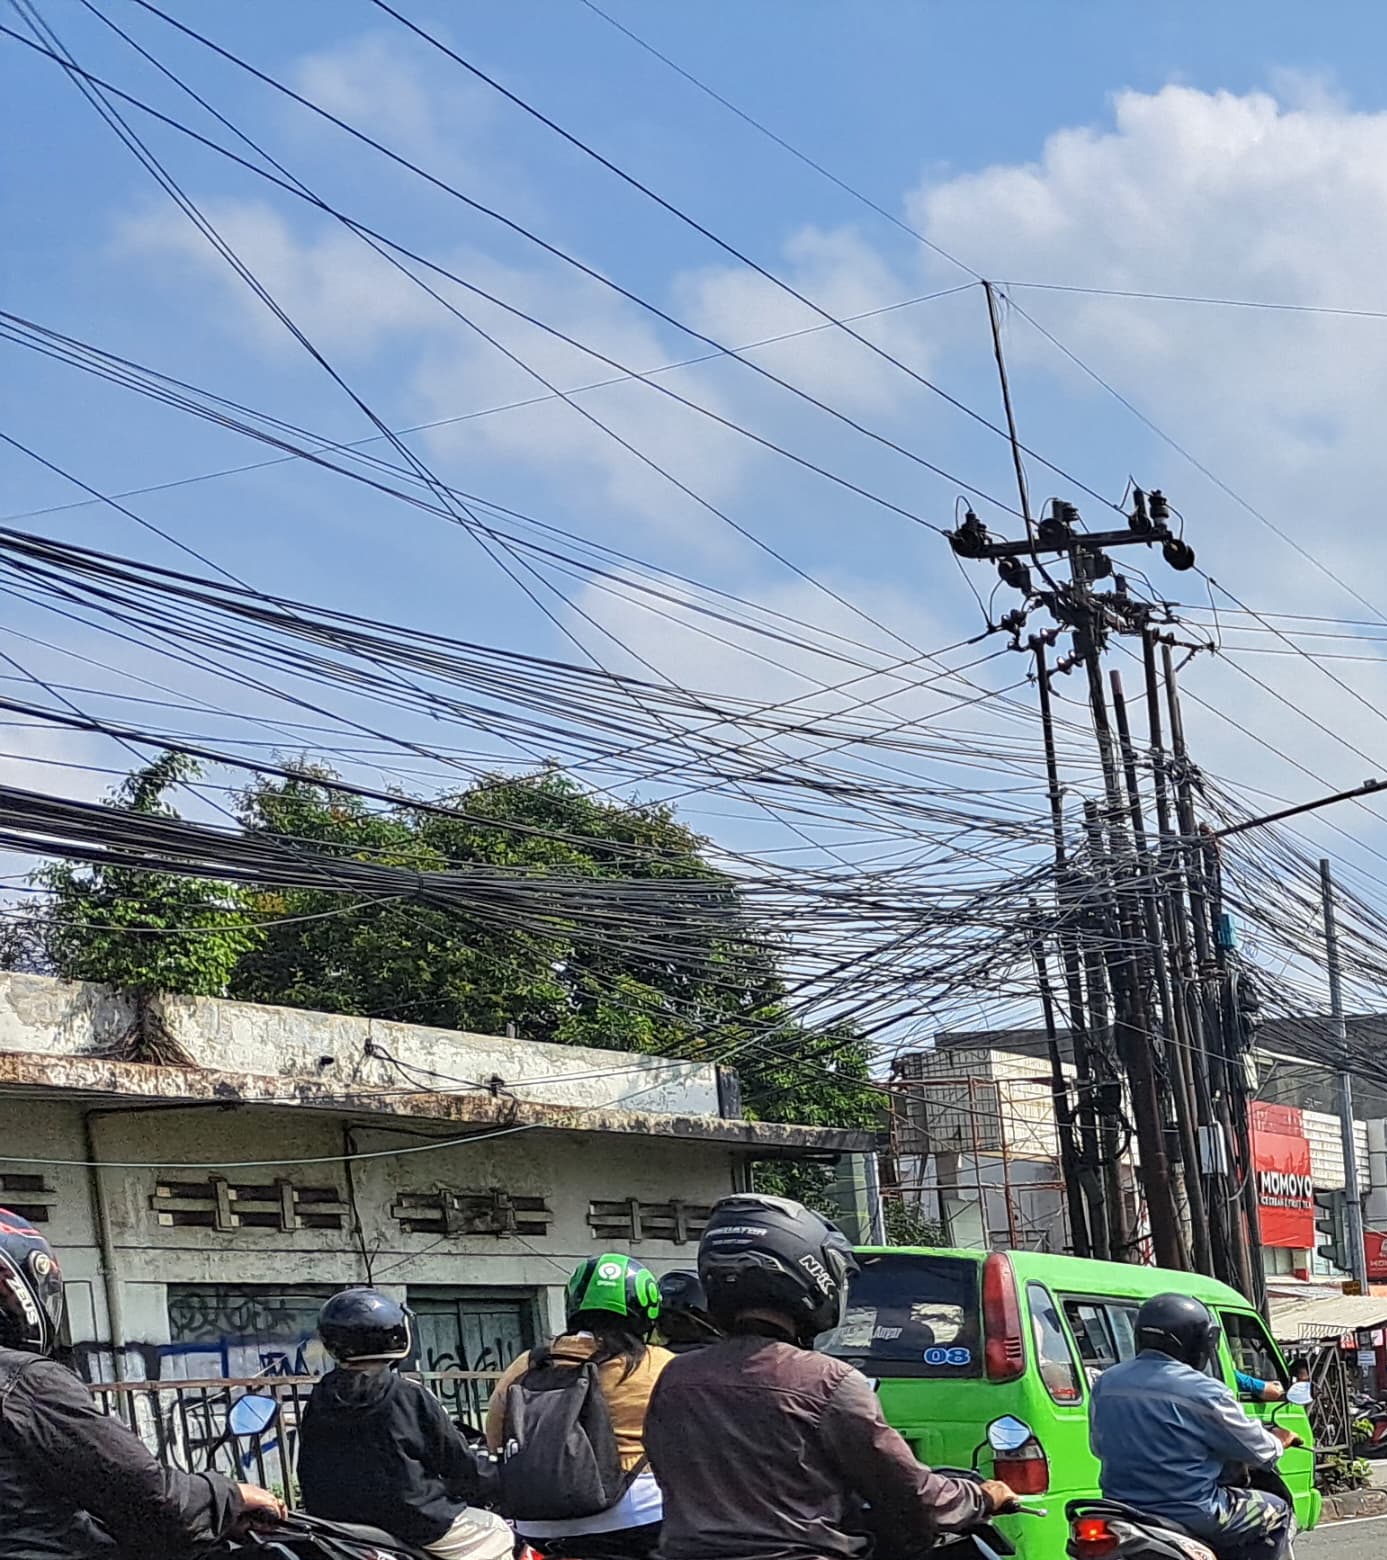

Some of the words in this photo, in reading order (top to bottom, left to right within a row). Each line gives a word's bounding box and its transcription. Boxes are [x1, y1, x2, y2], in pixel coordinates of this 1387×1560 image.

[1260, 1171, 1313, 1198] MOMOYO
[799, 1254, 837, 1296] NHK
[5, 1277, 40, 1326] ZEUS
[923, 1347, 970, 1365] 08
